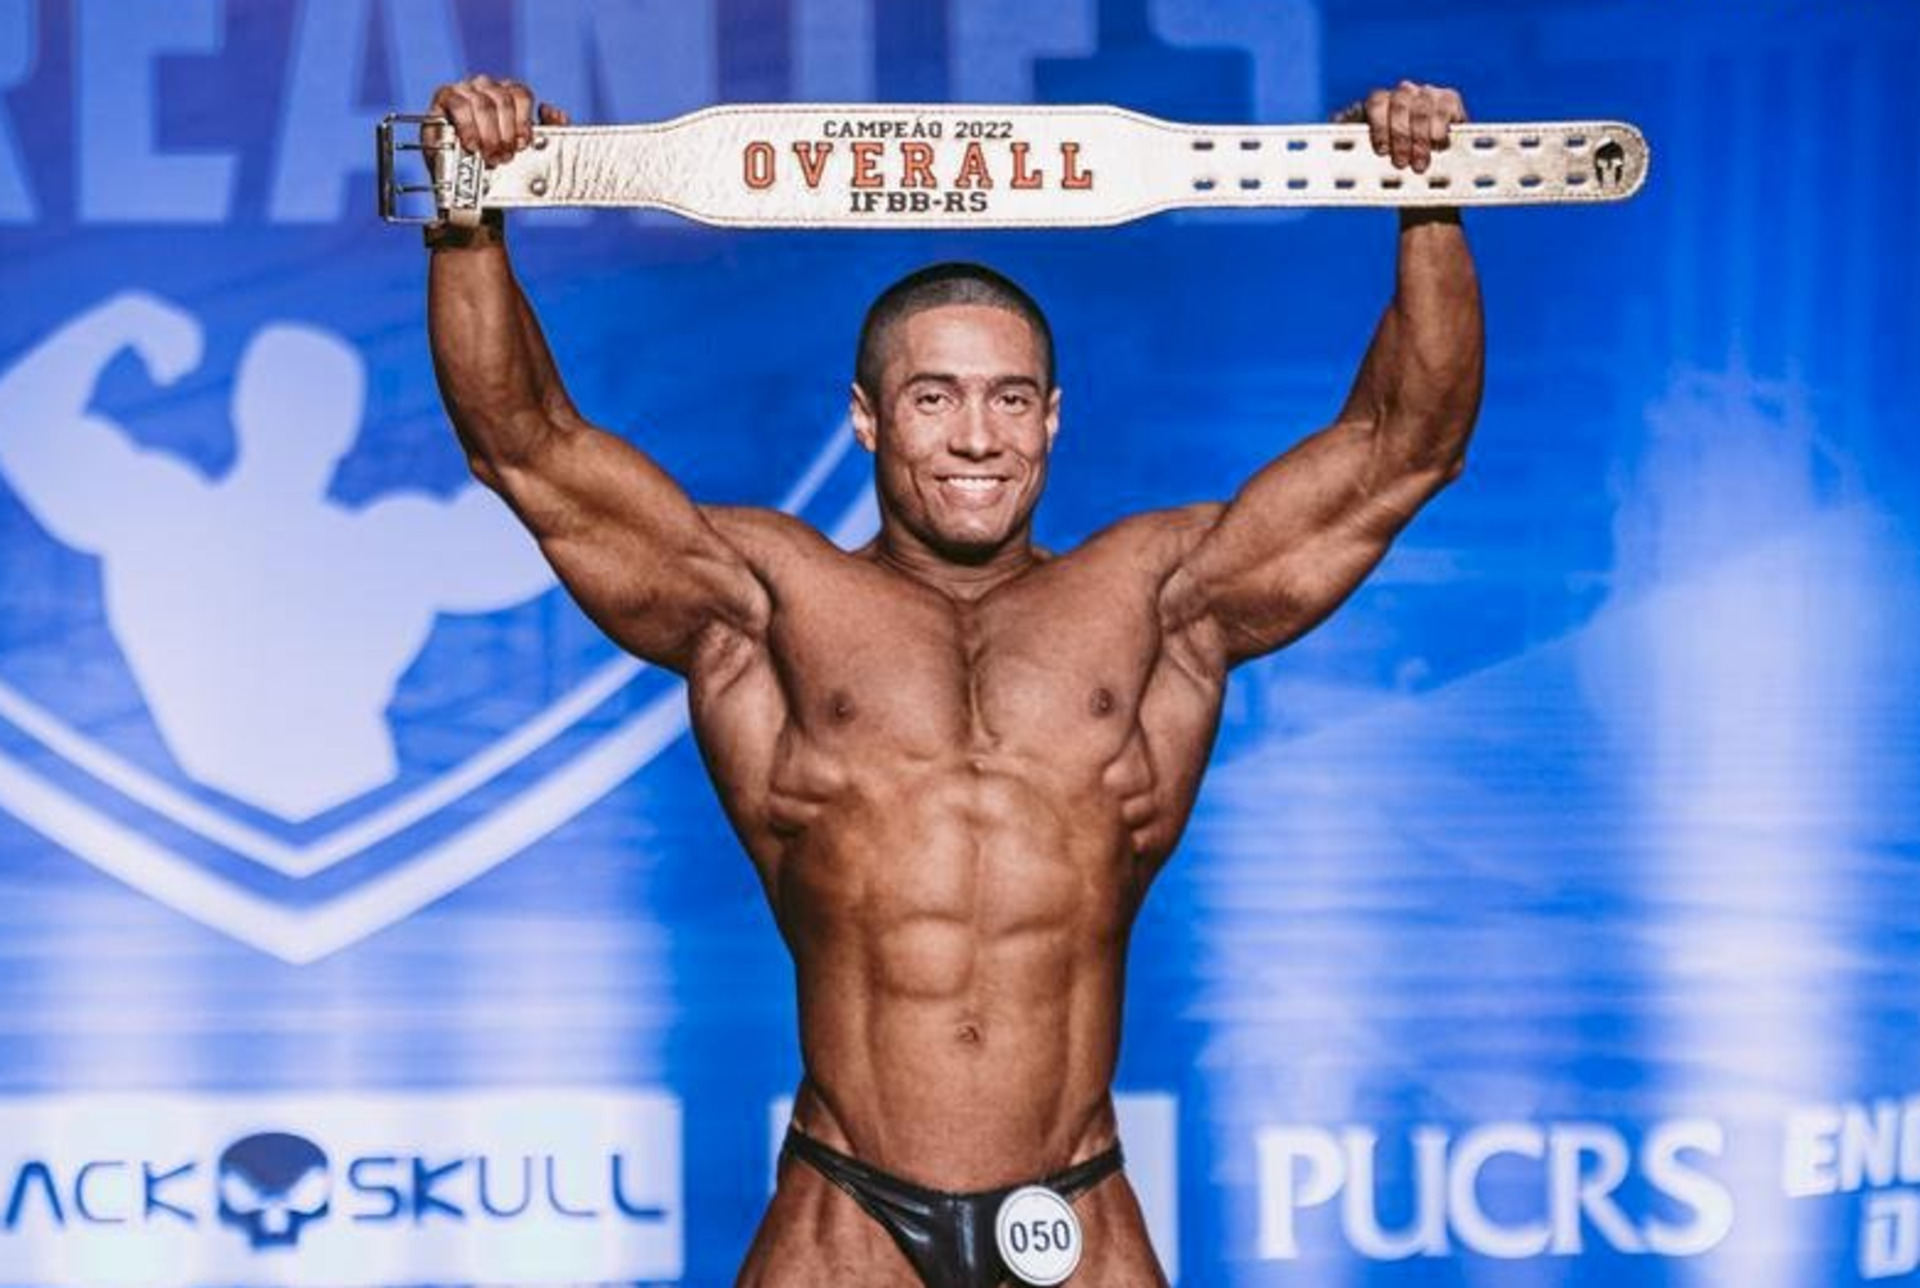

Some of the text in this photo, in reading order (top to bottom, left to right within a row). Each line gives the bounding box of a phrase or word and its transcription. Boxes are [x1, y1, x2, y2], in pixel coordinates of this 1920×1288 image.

[955, 121, 1013, 139] 2022
[744, 141, 1093, 190] OVERALL
[850, 191, 988, 213] IFBB-RS
[1784, 1094, 1920, 1197] EN
[347, 1154, 670, 1223] SKULL
[1258, 1119, 1734, 1262] PUCRS
[1010, 1219, 1070, 1254] 050
